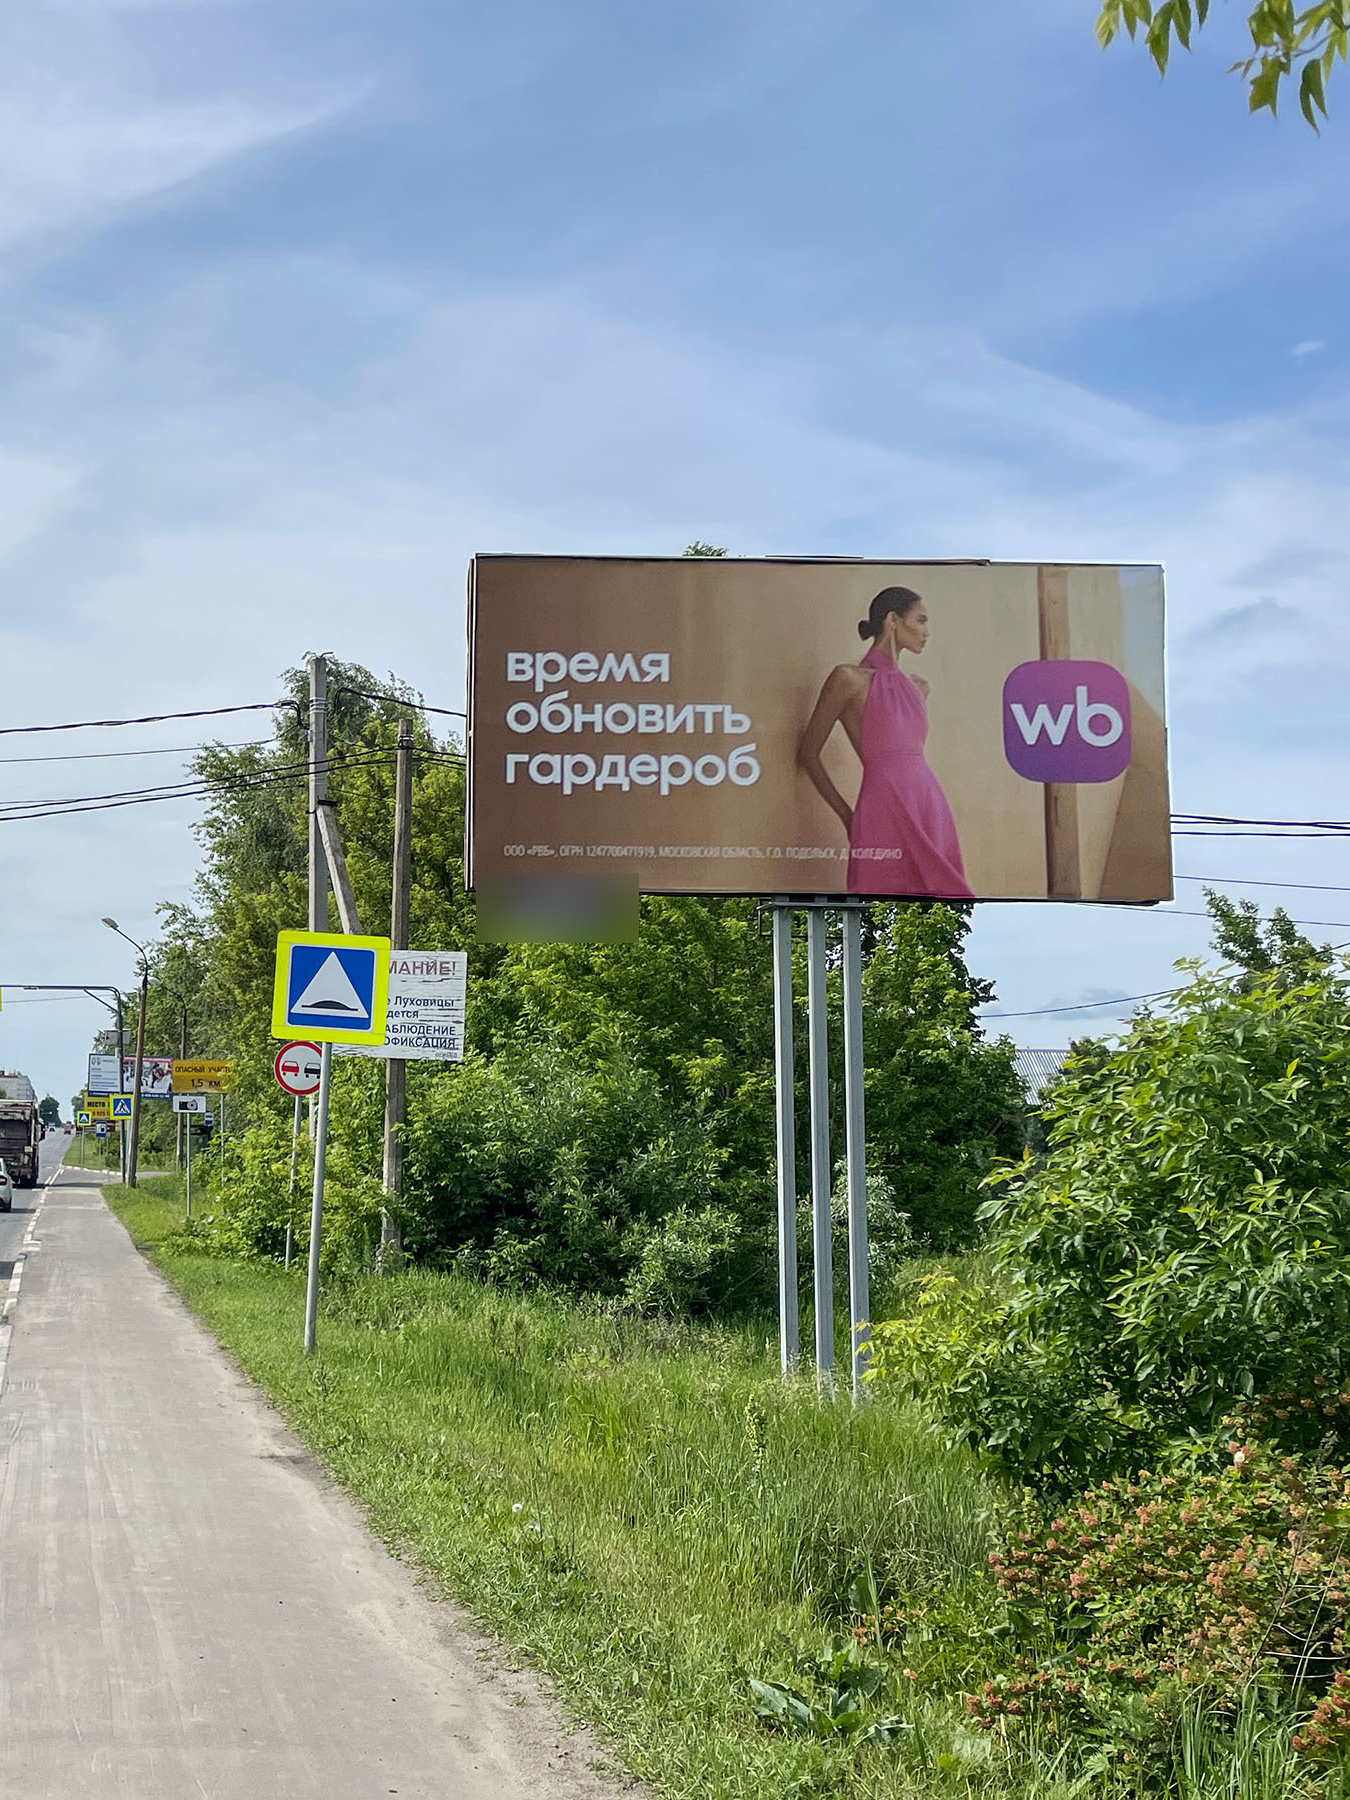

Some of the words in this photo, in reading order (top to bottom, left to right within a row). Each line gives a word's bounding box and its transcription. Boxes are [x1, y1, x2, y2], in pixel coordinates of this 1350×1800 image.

[507, 651, 670, 692] время
[506, 690, 751, 734] обновить
[1010, 685, 1123, 747] wb
[505, 743, 761, 795] гардероб
[504, 844, 525, 856] ООО
[559, 845, 584, 857] ОГРН
[851, 848, 903, 861] КОЛЕДИНО
[394, 995, 454, 1008] Луховицы
[175, 1065, 205, 1073] ОПАСНЫЙ
